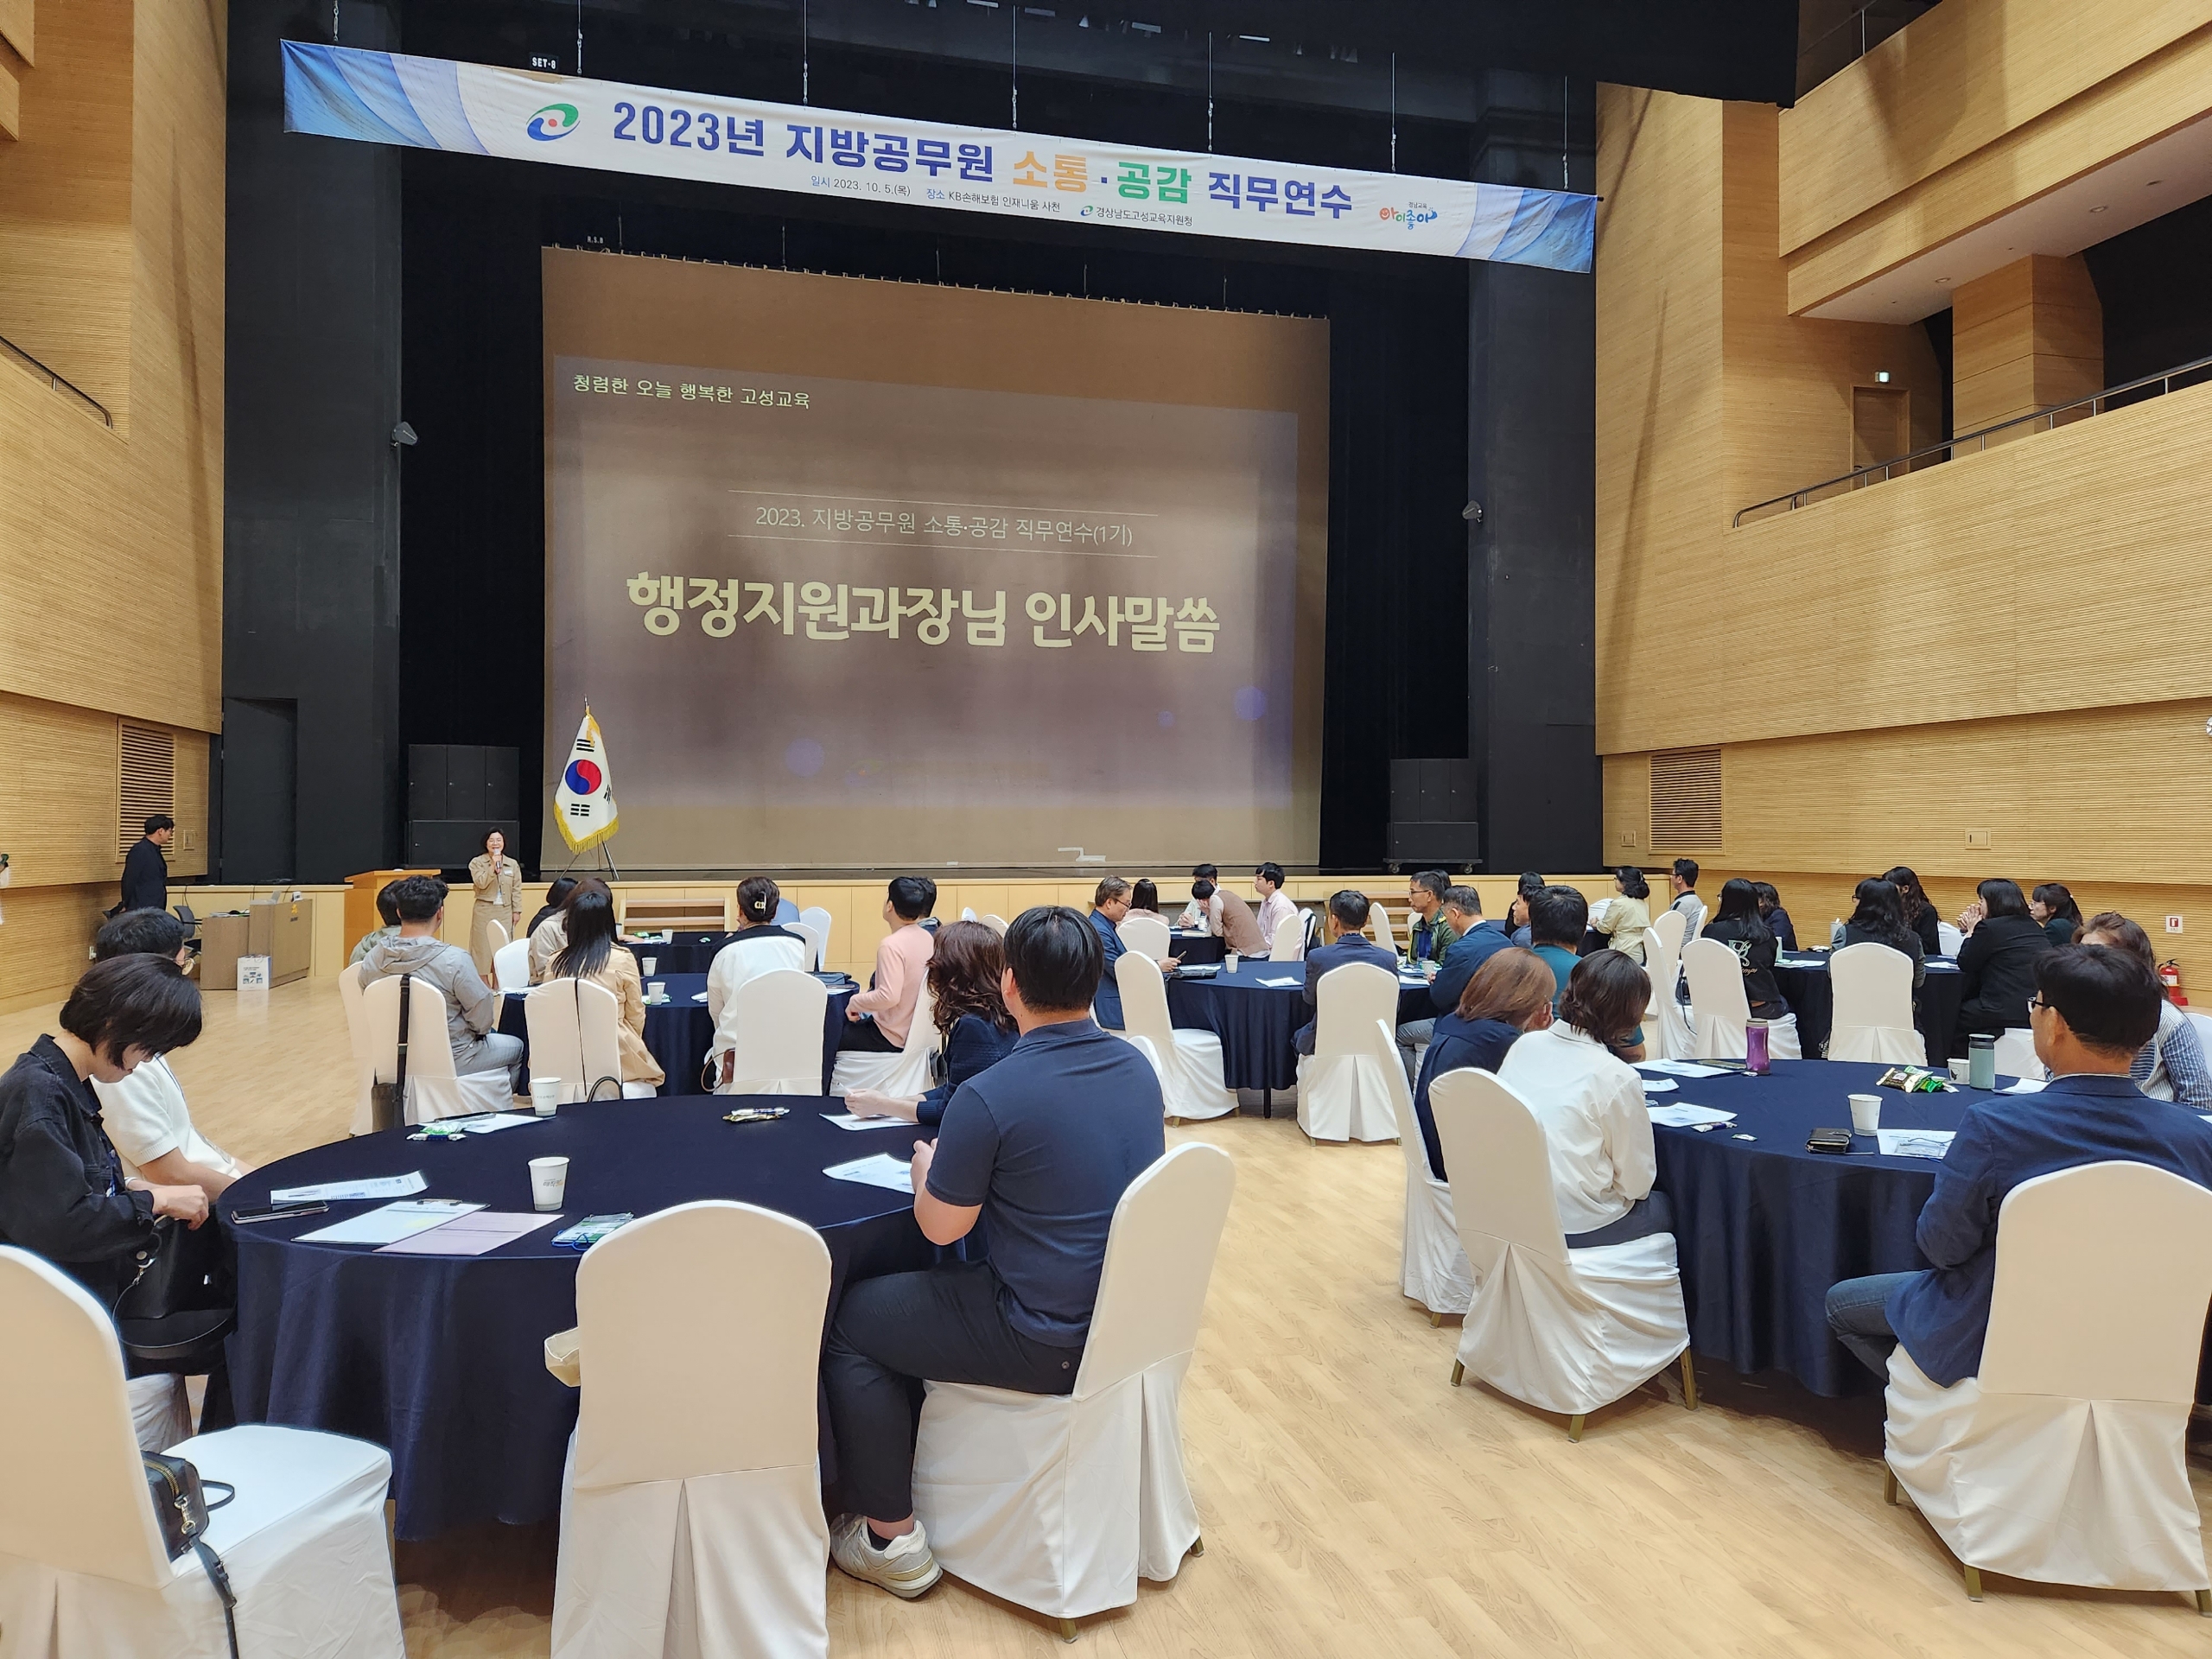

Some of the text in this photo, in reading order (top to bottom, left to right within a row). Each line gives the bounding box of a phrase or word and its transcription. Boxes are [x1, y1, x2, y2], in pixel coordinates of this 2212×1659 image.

[613, 101, 765, 157] 2023년
[785, 124, 994, 182] 지방공무원
[1208, 171, 1353, 219] 직무연수
[810, 175, 830, 188] 일시
[833, 178, 861, 191] 2023.
[926, 188, 1061, 213] 장소 KB손해보험 인재니움 사천
[1096, 207, 1192, 227] 경상남도고성교육지원청
[1379, 207, 1438, 231] 아이좋아
[573, 374, 810, 410] 청렴한 오늘 행복한 고성교육
[755, 506, 805, 528] 2023.
[812, 508, 916, 535] 지방공무원
[1014, 518, 1134, 547] 직무연수(1기)
[626, 570, 1221, 654] 행정지원과장님 인사말씀
